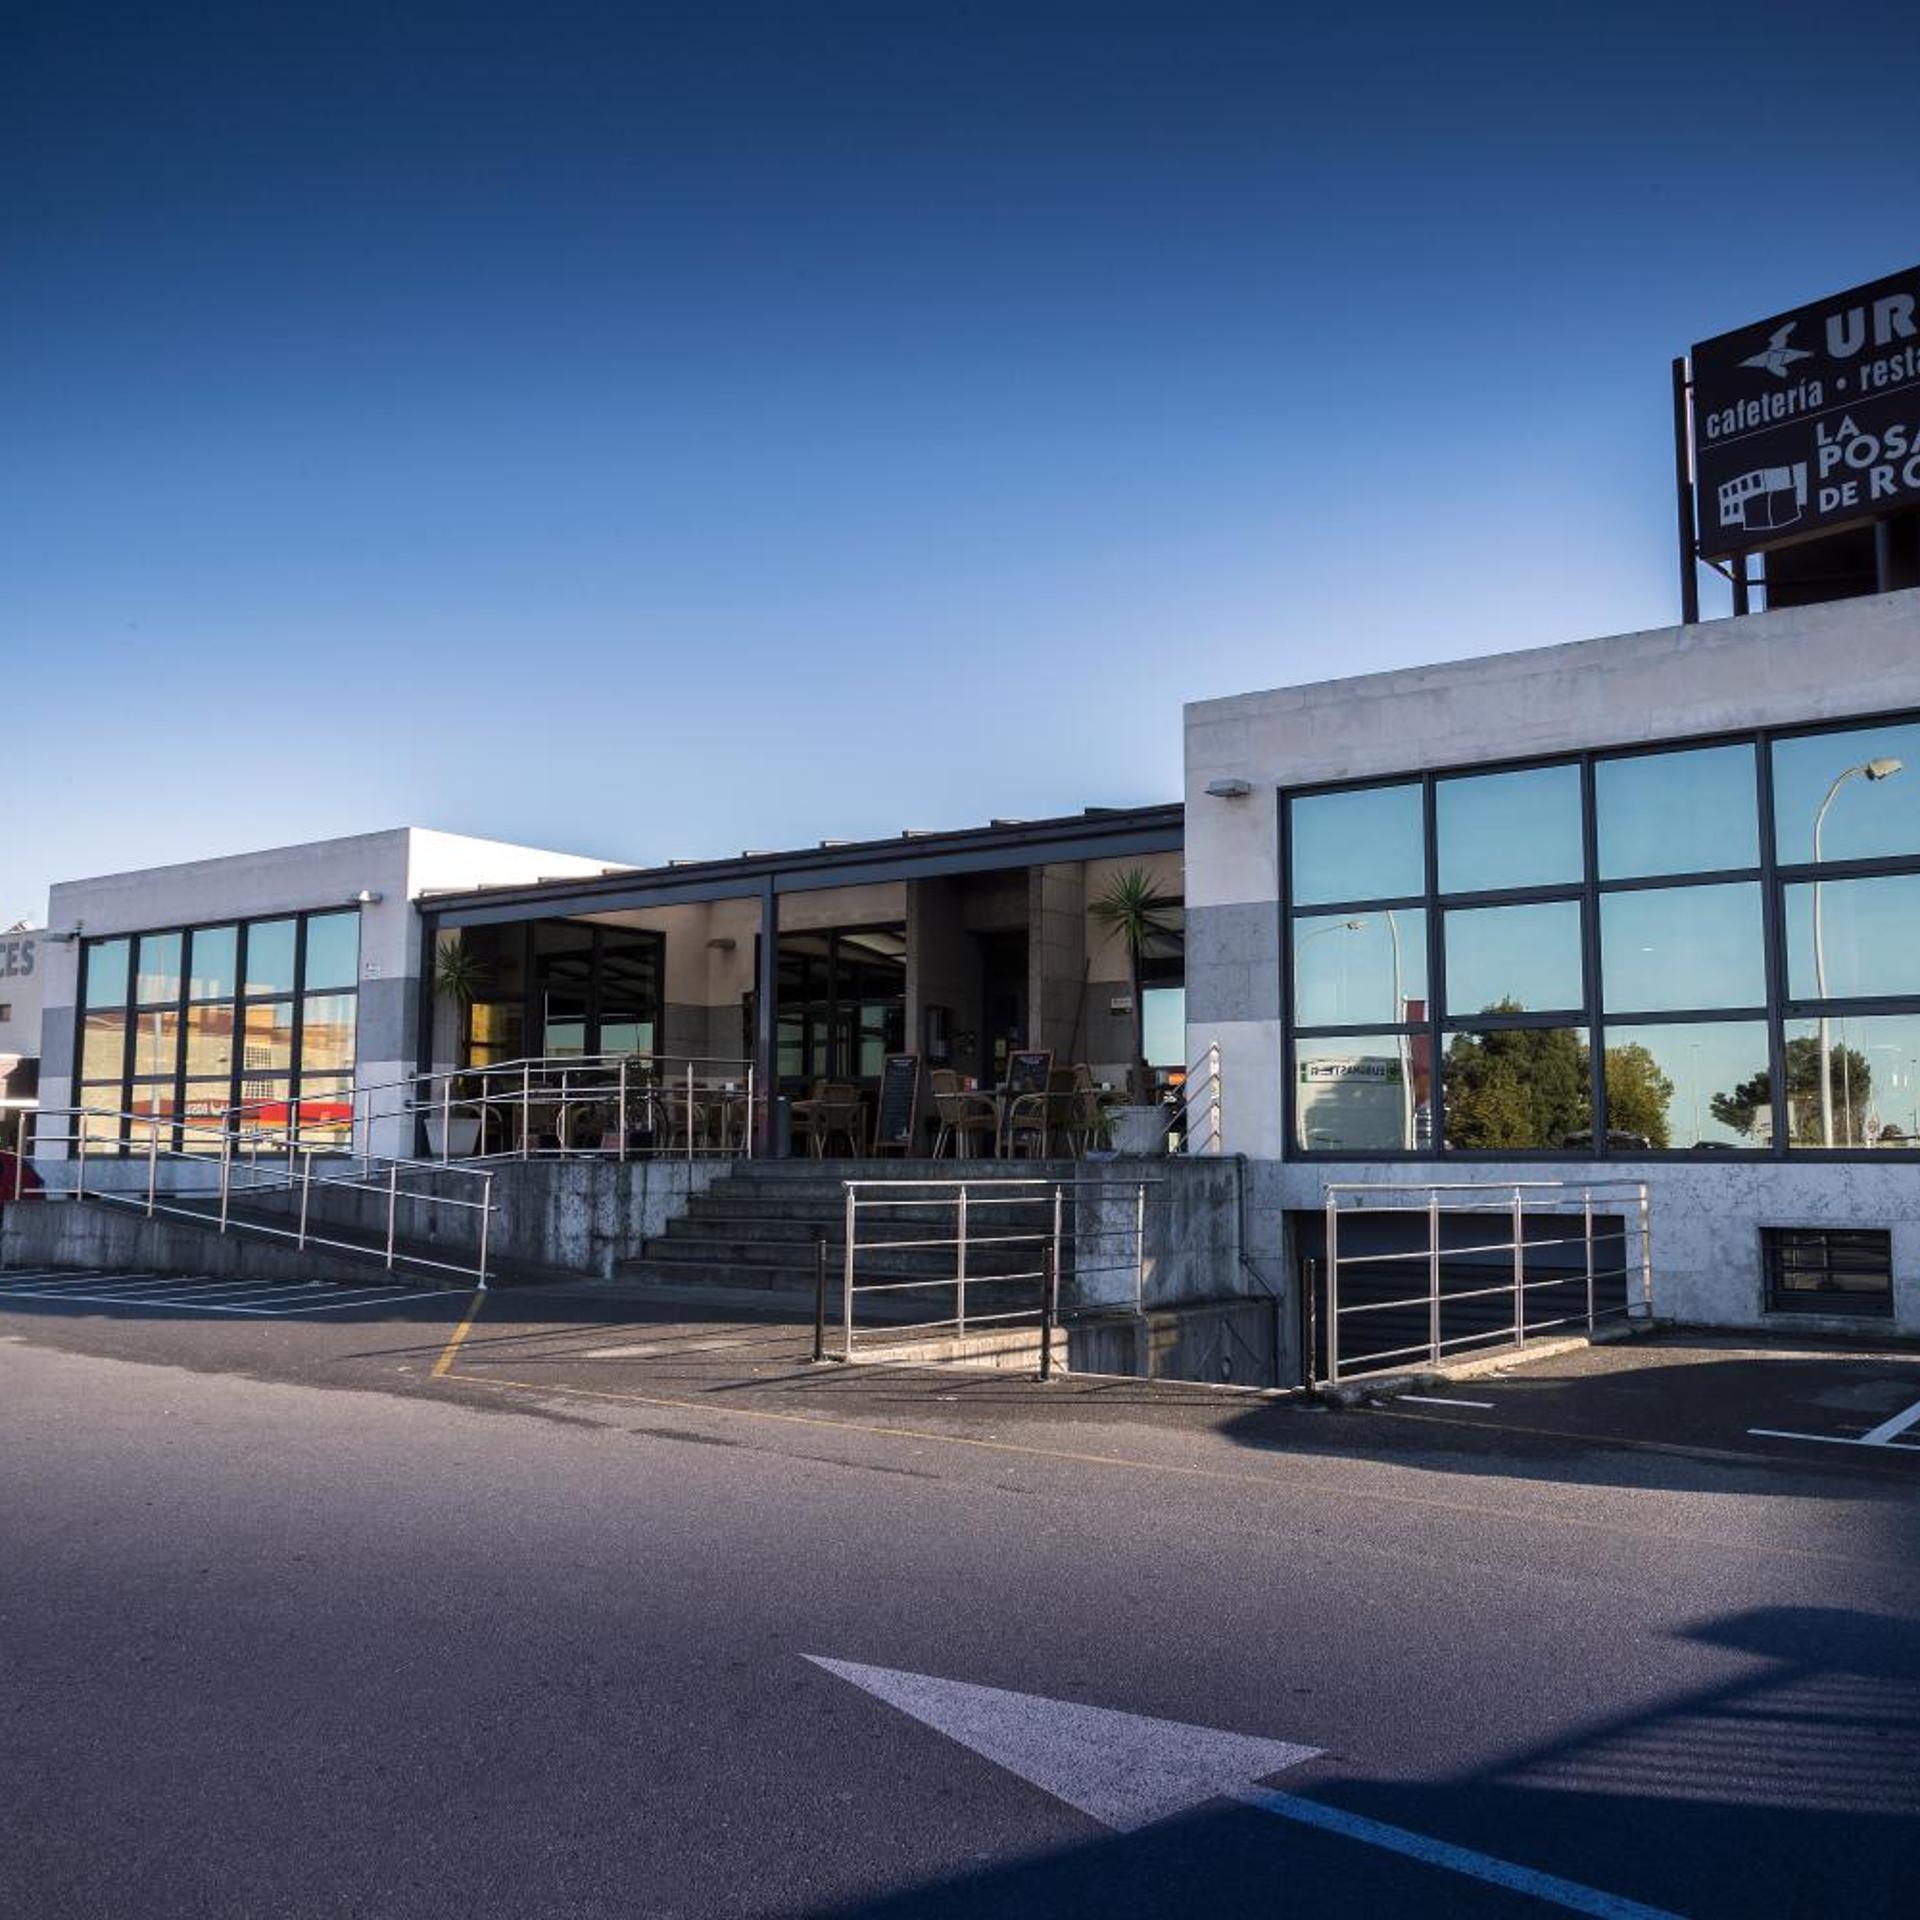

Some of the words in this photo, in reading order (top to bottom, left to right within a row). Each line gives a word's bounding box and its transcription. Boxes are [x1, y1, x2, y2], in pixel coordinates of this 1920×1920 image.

[1826, 293, 1917, 358] UR
[1706, 377, 1823, 439] cafetería
[1860, 346, 1920, 391] rest
[1816, 414, 1860, 446] LA
[1819, 480, 1859, 513] DE
